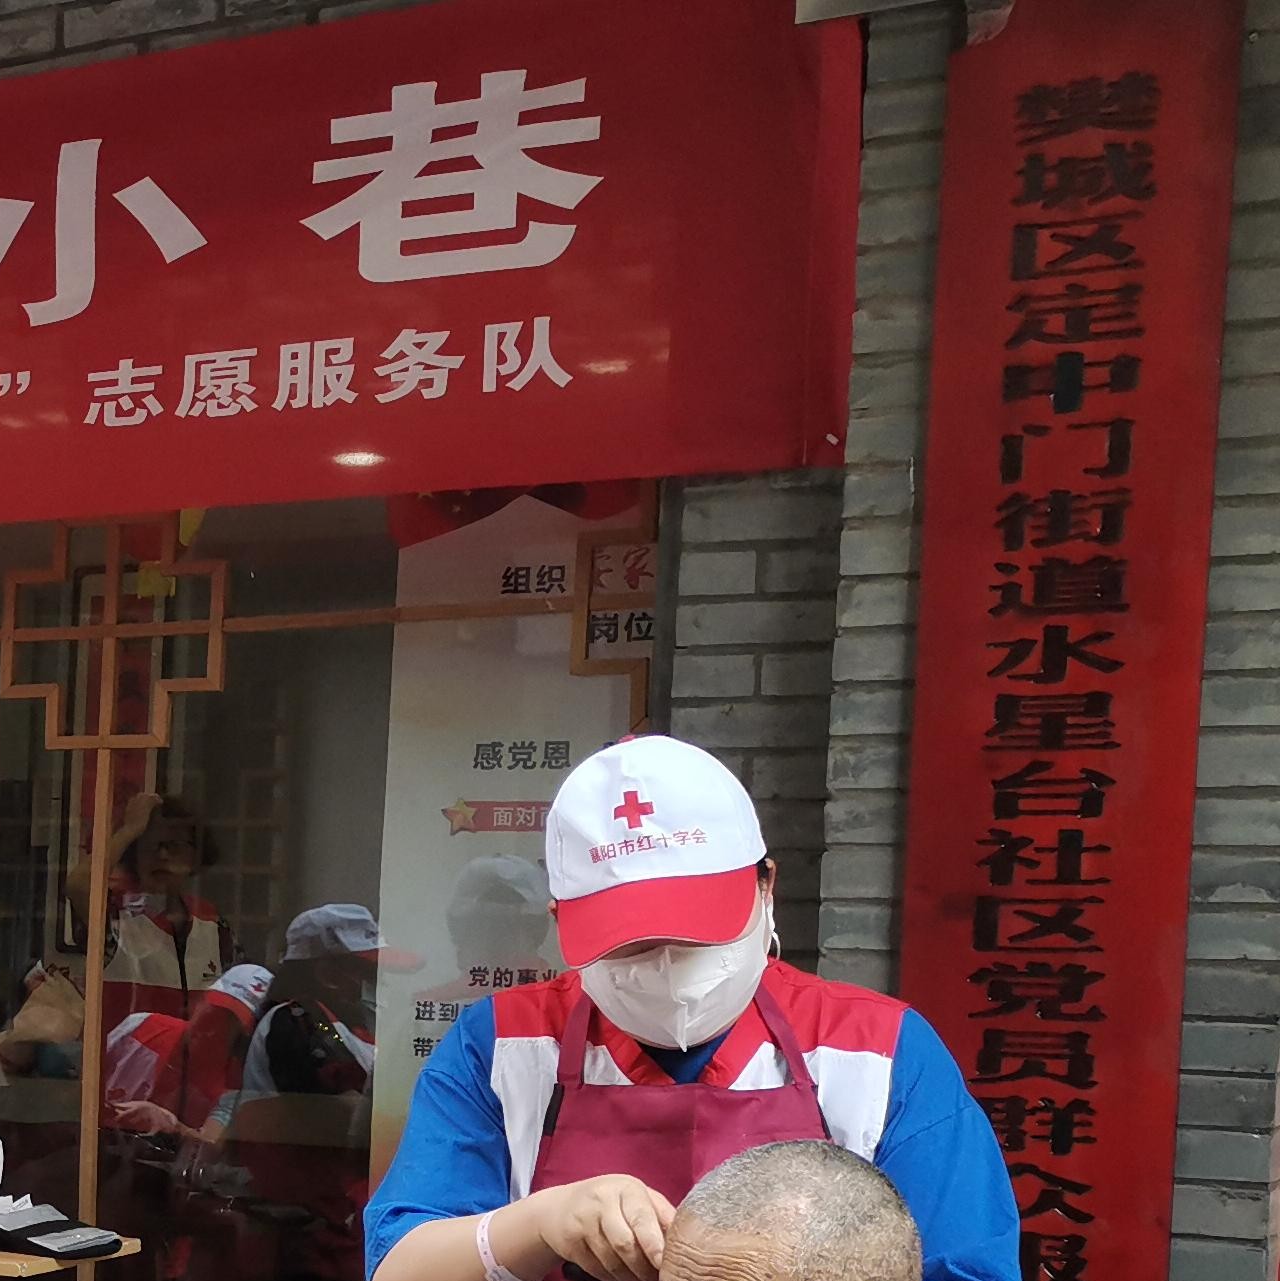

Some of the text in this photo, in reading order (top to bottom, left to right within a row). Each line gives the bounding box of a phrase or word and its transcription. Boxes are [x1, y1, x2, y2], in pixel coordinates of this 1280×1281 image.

[500, 564, 567, 594] 组织
[590, 611, 656, 644] 岗位
[472, 740, 572, 770] 感党恩
[588, 827, 709, 864] 襄阳市红十字会
